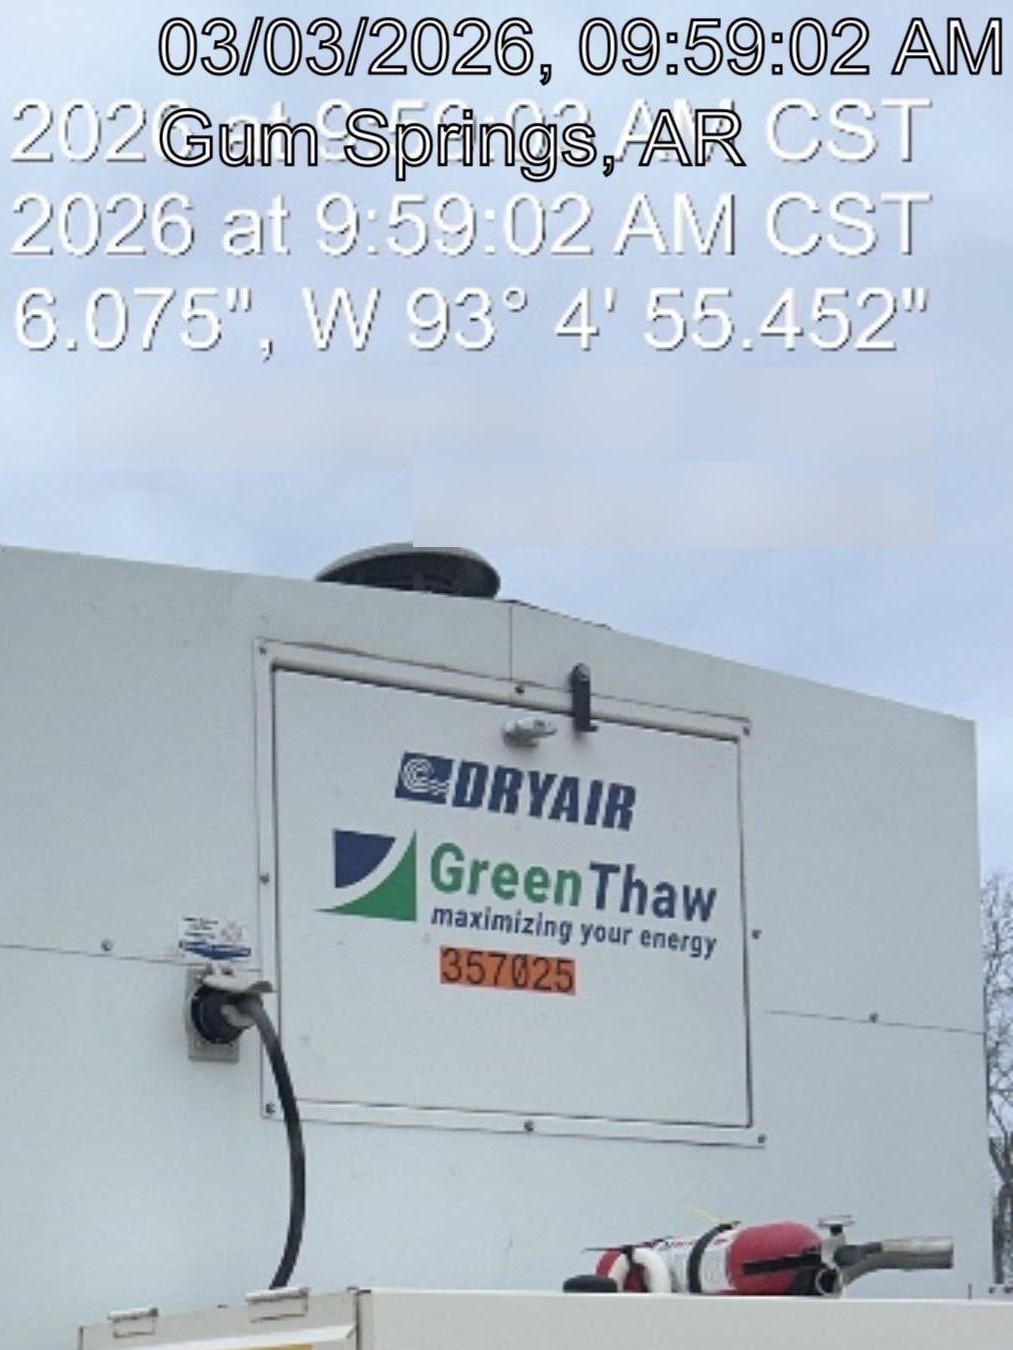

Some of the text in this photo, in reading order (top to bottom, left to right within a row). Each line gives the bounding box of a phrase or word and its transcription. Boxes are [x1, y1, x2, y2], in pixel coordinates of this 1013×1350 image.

[451, 760, 637, 831] DRYAIR
[431, 906, 718, 961] maximizing your energy
[440, 947, 575, 994] 357025
